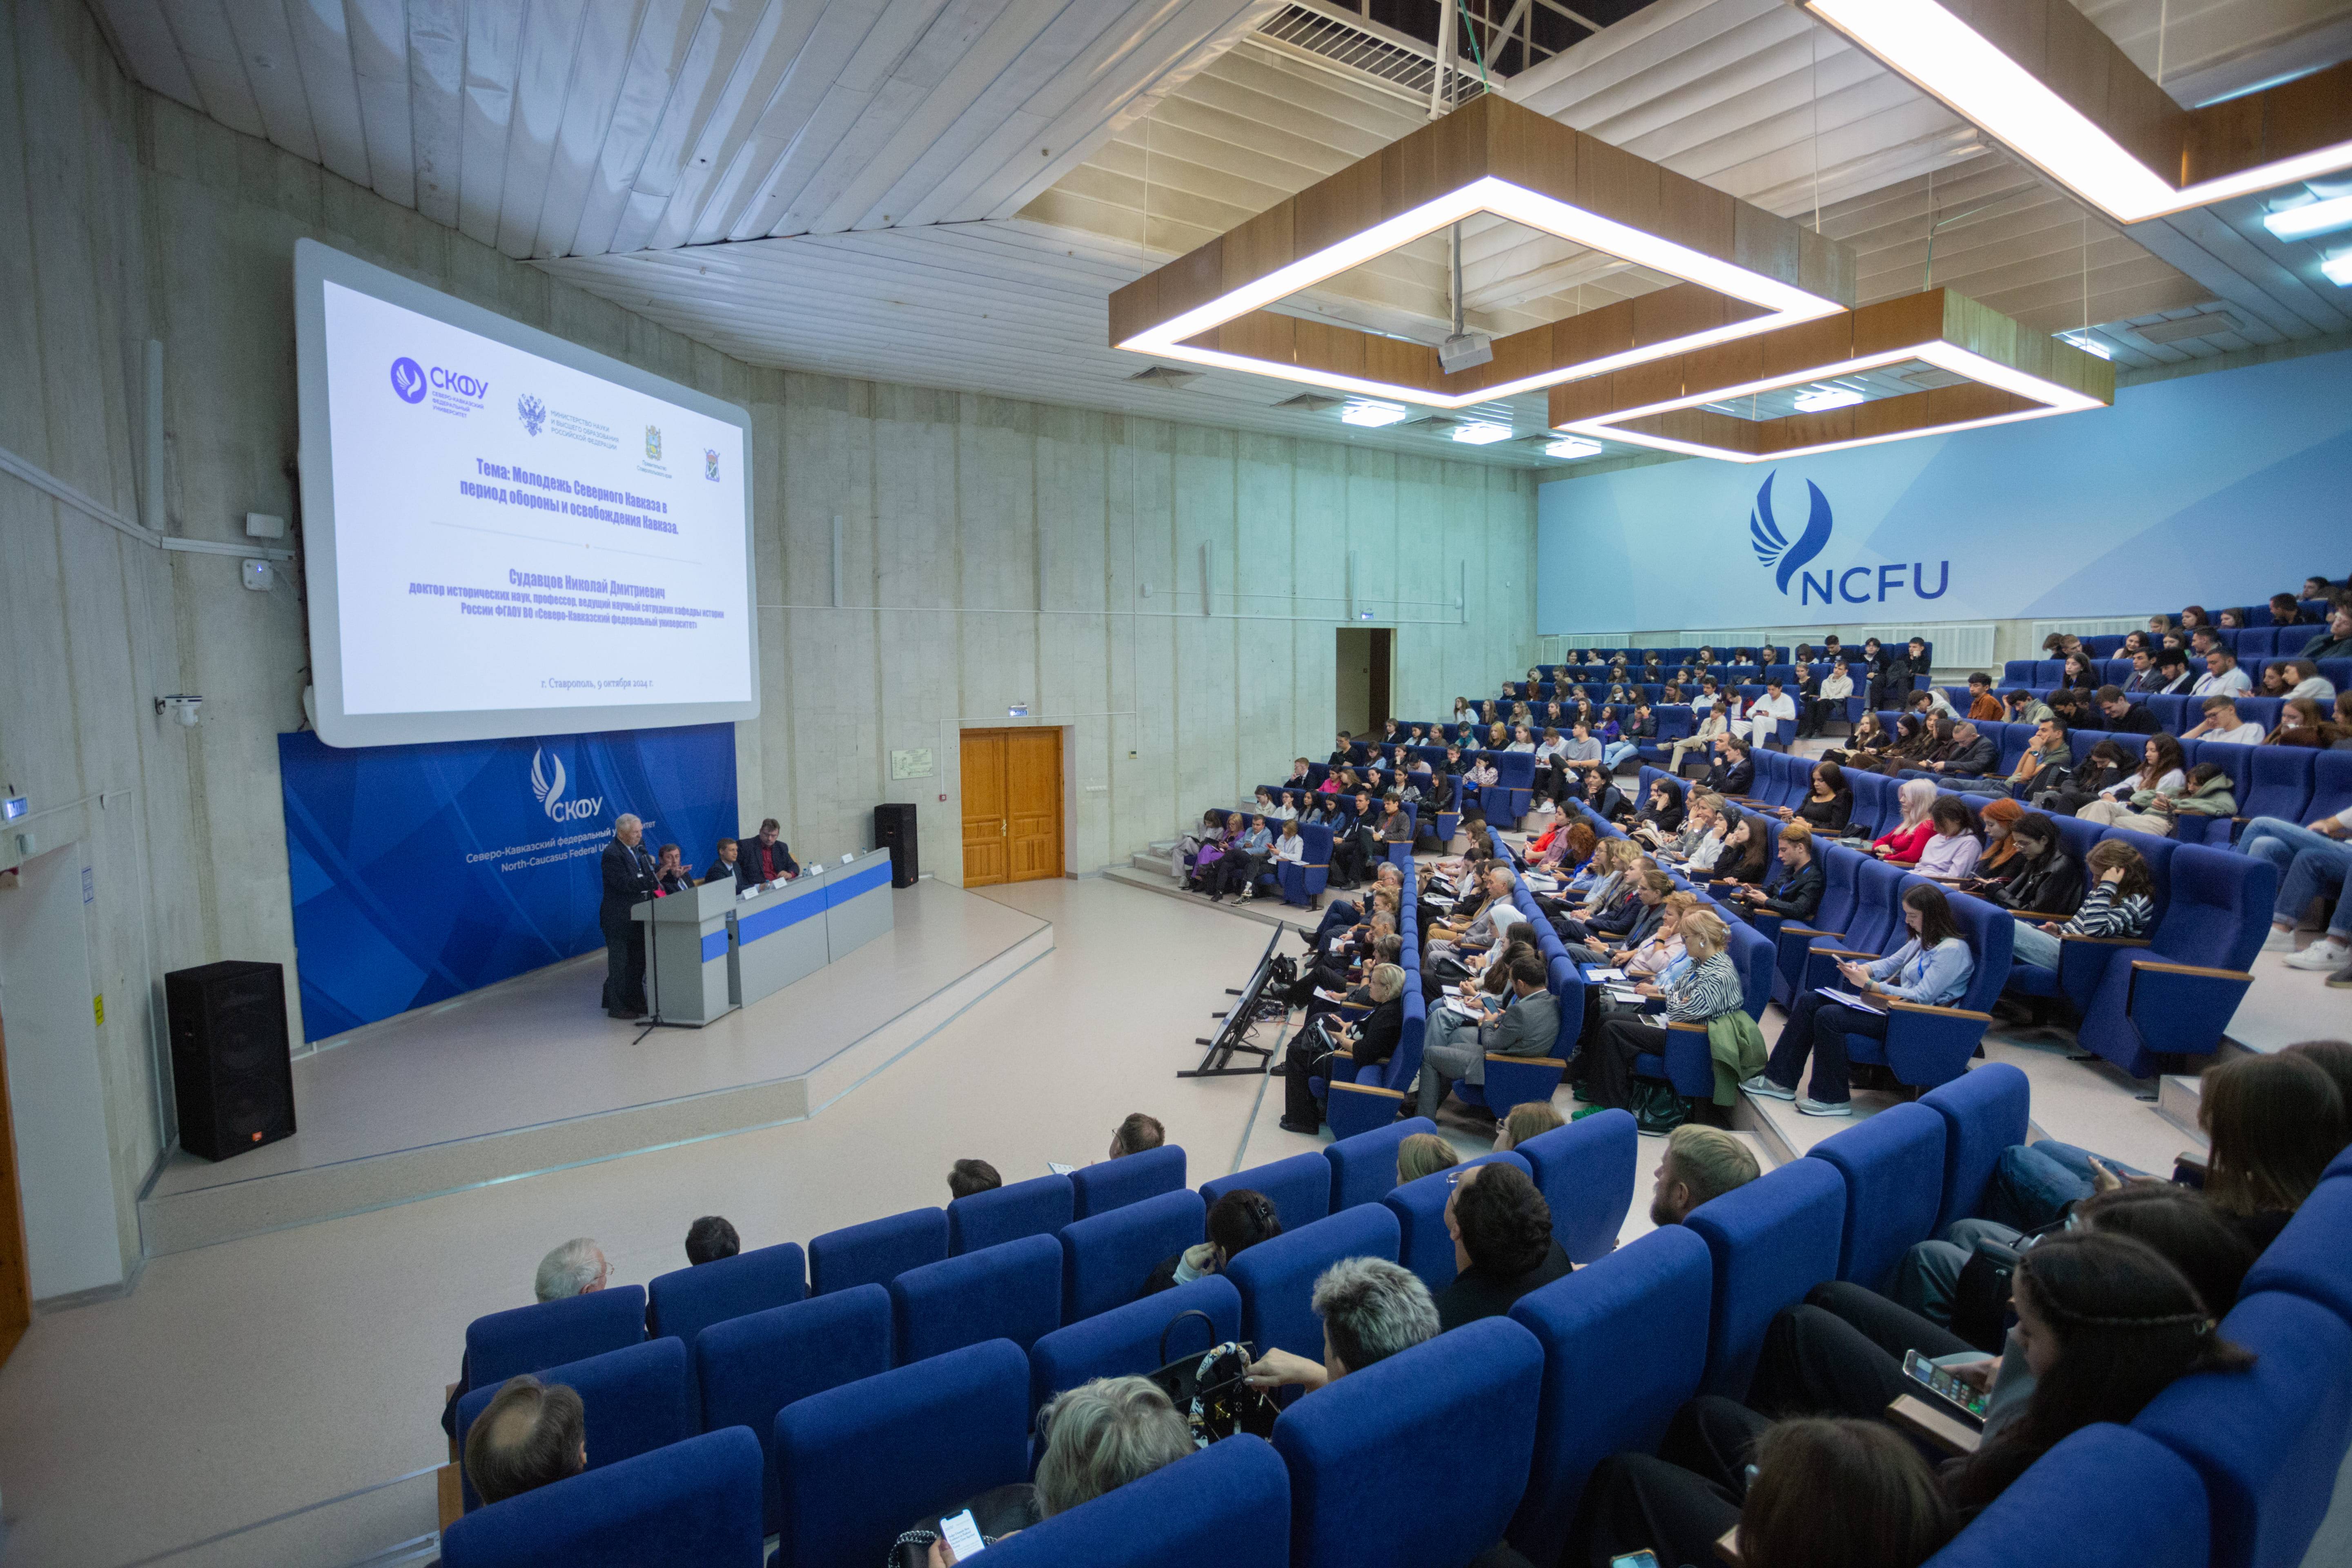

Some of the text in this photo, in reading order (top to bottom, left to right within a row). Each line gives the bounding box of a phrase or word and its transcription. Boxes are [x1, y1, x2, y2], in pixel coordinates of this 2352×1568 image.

[430, 366, 488, 399] СКФУ
[432, 391, 484, 409] СЕВЕРО-КАВКАЗСКИЙ
[432, 398, 470, 412] ФЕДЕРАЛЬНЫЙ
[432, 405, 467, 418] УНИВЕРСИТЕТ
[551, 410, 609, 432] МИНИСТЕРСТВО НАУКИ
[556, 420, 582, 432] ВЫСШЕГО
[583, 428, 619, 443] ОБРАЗОВАНИЯ
[551, 428, 617, 450] РОССИЙСКОЙ ФЕДЕРАЦИИ
[477, 458, 667, 514] Тема: Молодежь Северного Кавказа в
[460, 481, 679, 535] период обороны и освобождения Кавказа.
[509, 568, 665, 599] Судавцов Николай Дмитриевич
[1801, 560, 1949, 606] NCFU
[409, 582, 724, 619] доктор исторических наук, профессор, ведущий научный сотрудник кафедры истории
[461, 602, 697, 630] России ФГАОУ ВО «Северо-Кавказский федеральный университет»
[549, 678, 596, 690] Ставрополь,
[597, 680, 602, 690] 9
[604, 678, 631, 690] октября
[633, 680, 647, 689] 2024
[552, 797, 603, 823] СКФУ
[466, 838, 556, 863] Северо-Кавказский
[557, 827, 611, 847] федеральный
[501, 852, 568, 873] North-Caucasus
[569, 844, 597, 857] Federal
